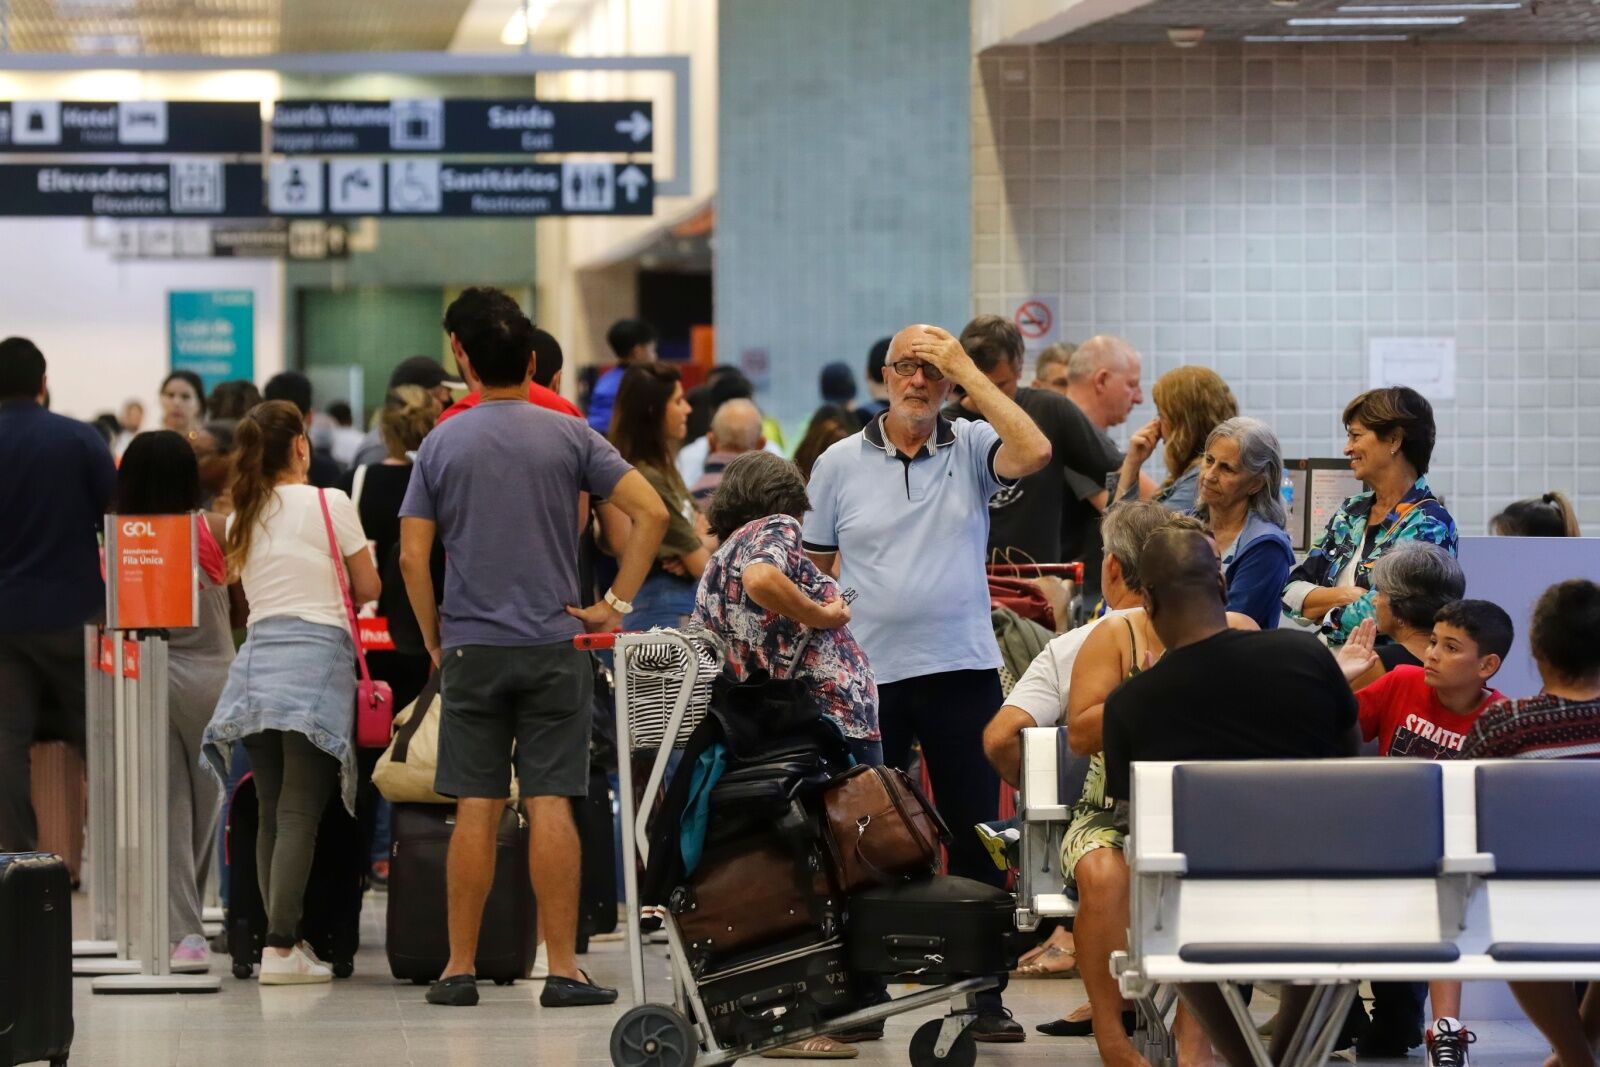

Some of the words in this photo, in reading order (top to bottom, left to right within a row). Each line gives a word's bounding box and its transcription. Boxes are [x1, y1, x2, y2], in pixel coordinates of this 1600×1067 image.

[63, 105, 116, 128] Hotel
[488, 106, 554, 128] Saída
[522, 132, 553, 150] Exit
[38, 168, 167, 191] Elevadores
[441, 168, 558, 191] Sanitários
[93, 195, 167, 212] Elevators
[123, 521, 156, 537] GOL
[123, 555, 138, 565] Fila
[140, 553, 163, 565] Única
